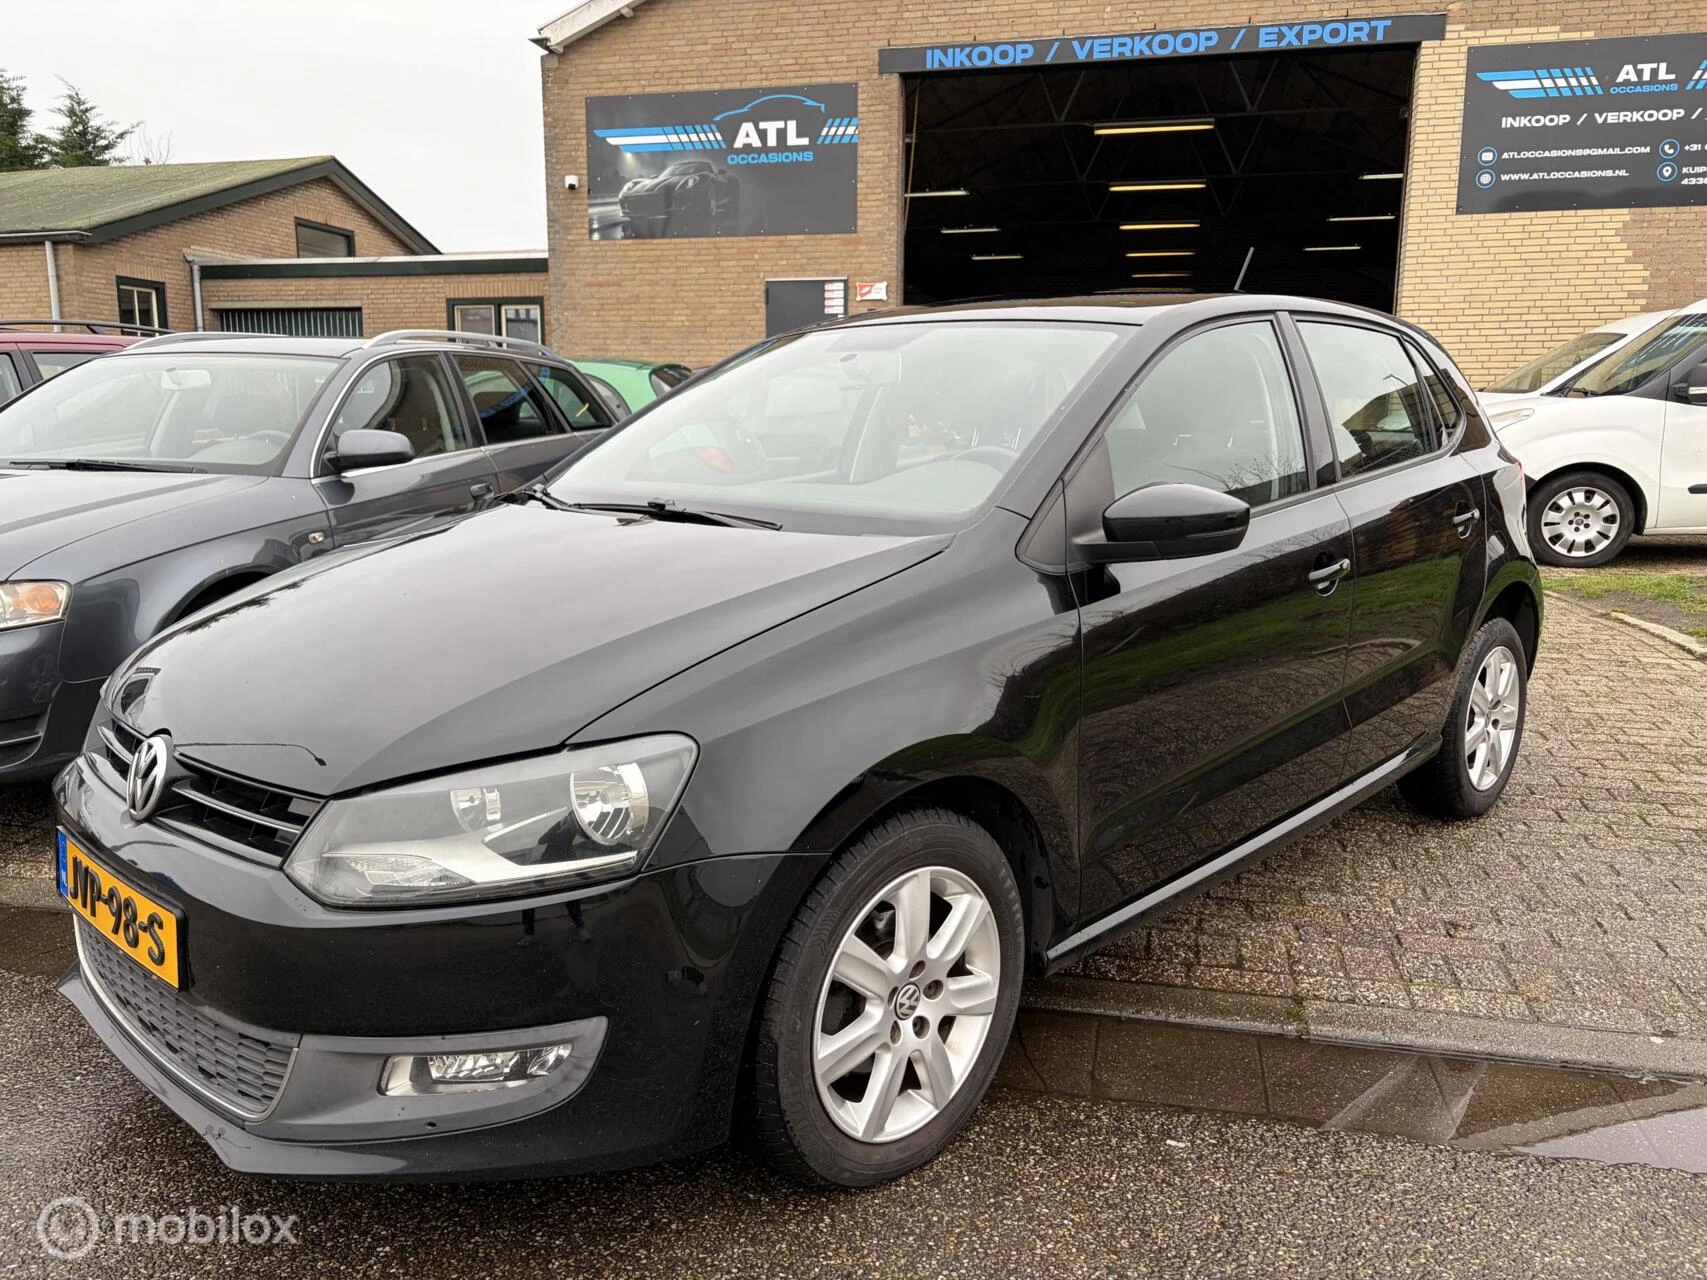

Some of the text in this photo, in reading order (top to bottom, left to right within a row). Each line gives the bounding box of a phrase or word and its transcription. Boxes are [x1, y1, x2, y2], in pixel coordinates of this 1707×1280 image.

[924, 44, 1035, 70] INKOOP
[1072, 30, 1220, 61] VERKOOP
[1258, 19, 1392, 49] EXPORT
[1616, 62, 1676, 83] ATL
[1610, 83, 1678, 94] OCCASIONS
[1501, 114, 1571, 128] INKOOP
[1594, 109, 1685, 124] VERKOOP
[733, 120, 810, 148] ATL
[727, 151, 814, 166] OCCASIONS
[1500, 169, 1630, 181] WWW.ATLOCCASIONS.NL
